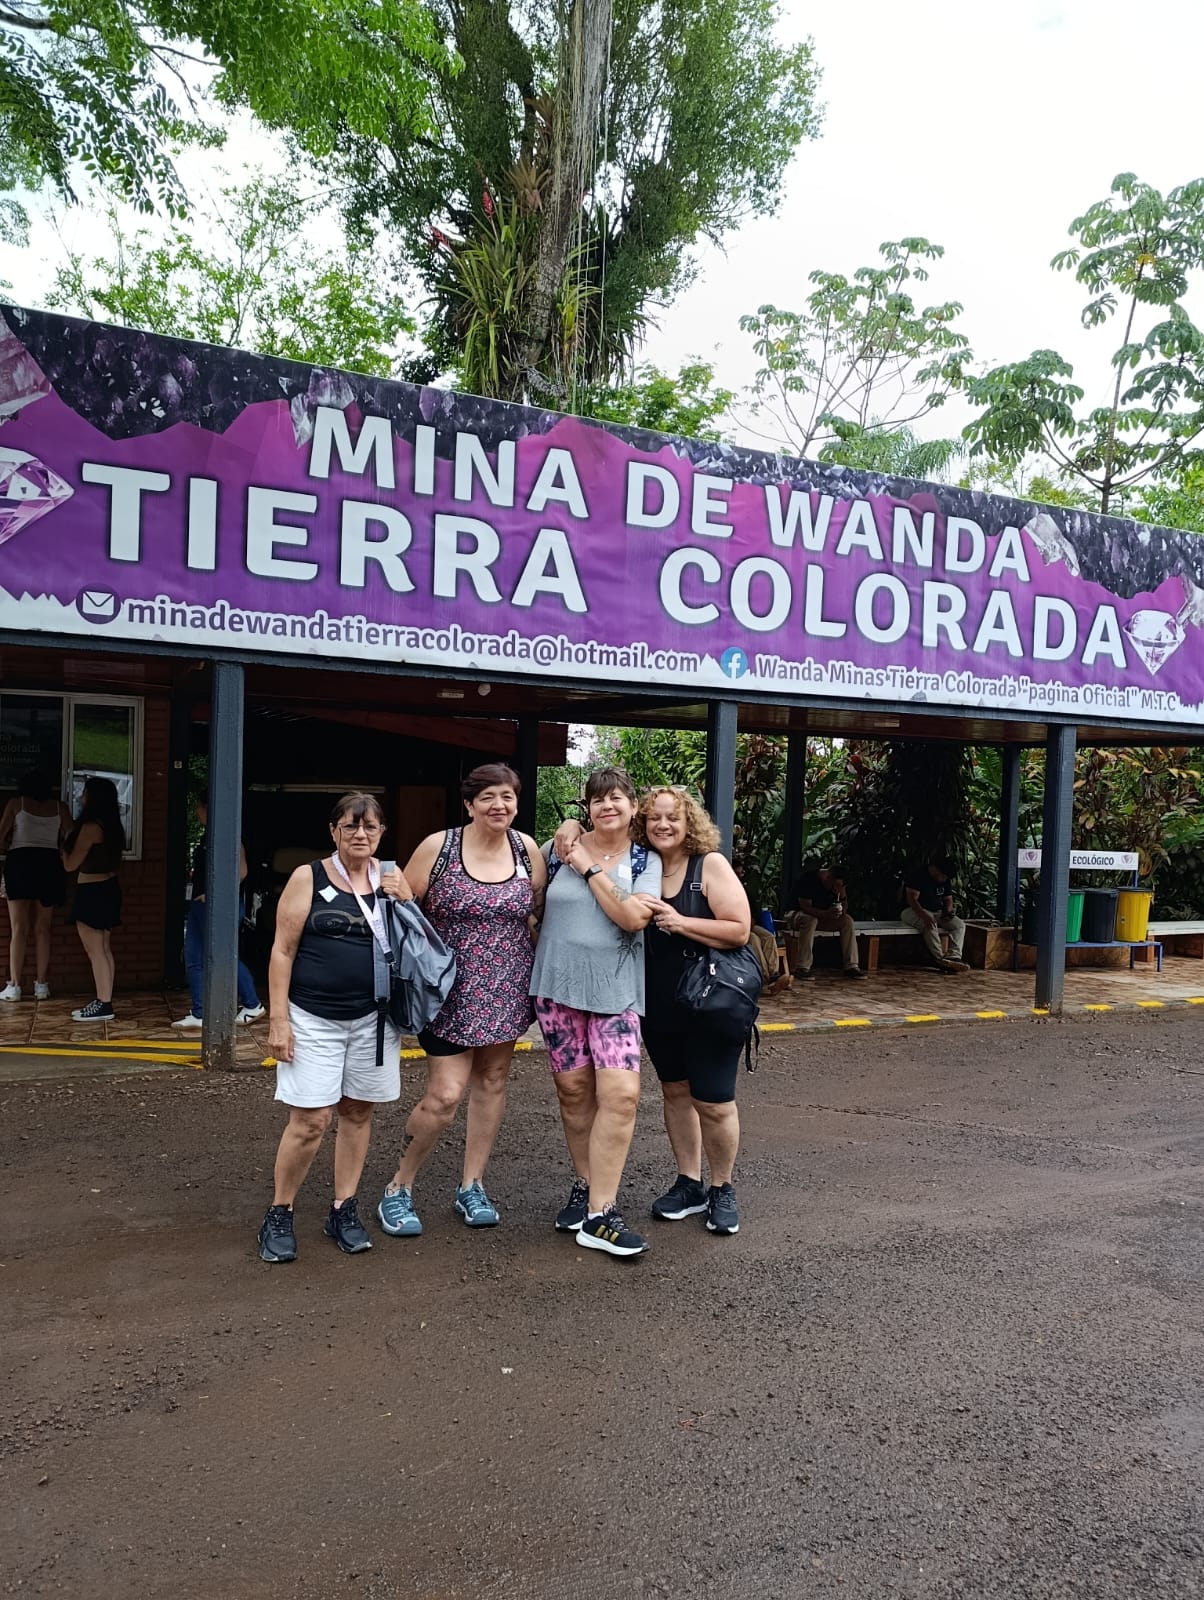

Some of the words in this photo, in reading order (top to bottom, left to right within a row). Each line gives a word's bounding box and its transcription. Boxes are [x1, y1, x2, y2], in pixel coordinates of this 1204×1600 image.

[309, 406, 590, 519] MINA
[626, 461, 735, 539] DE
[764, 484, 1031, 583] WANDA
[81, 462, 589, 613] TIERRA
[659, 547, 1127, 669] COLORADA
[127, 600, 698, 672] minadewandatierracolorada@hotmail.com
[758, 656, 823, 682] Wanda
[829, 664, 885, 687] Minas
[889, 668, 940, 691] Tierra
[945, 673, 1017, 698] Colorada
[1072, 854, 1115, 866] ECOLÓGICO
